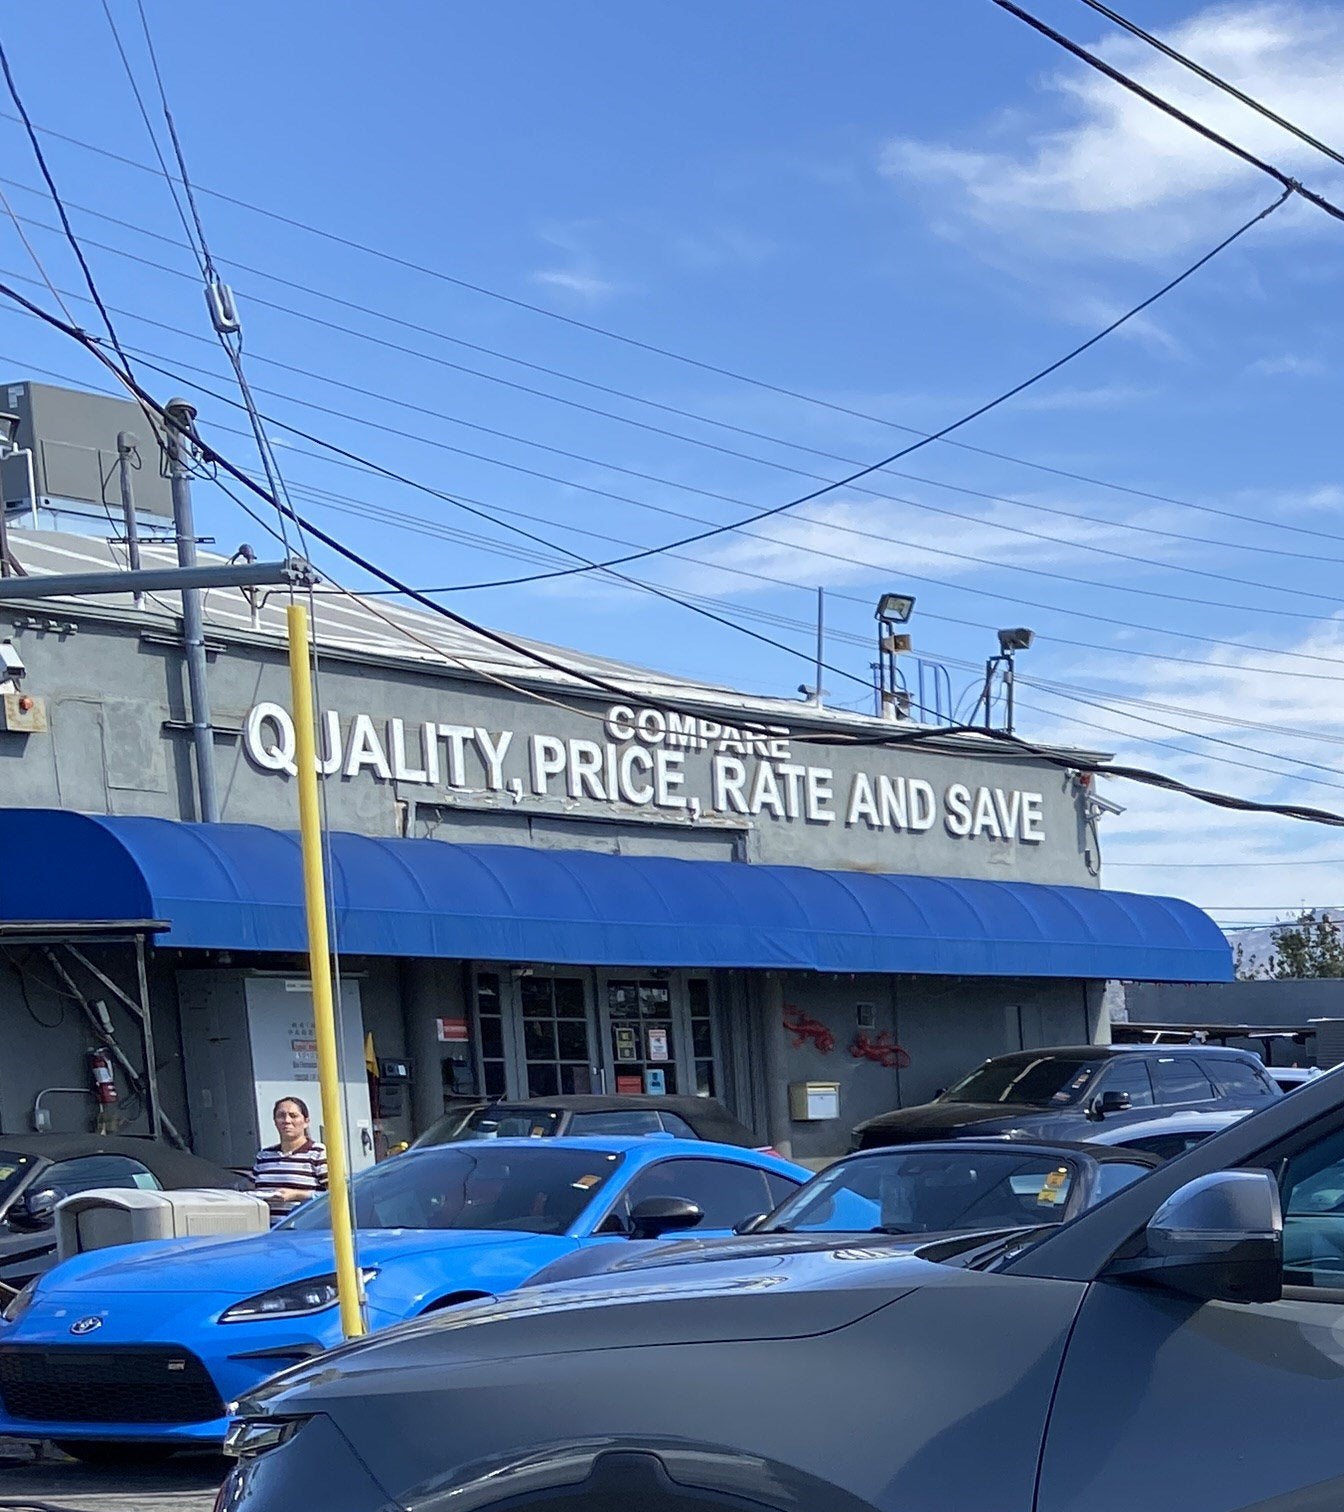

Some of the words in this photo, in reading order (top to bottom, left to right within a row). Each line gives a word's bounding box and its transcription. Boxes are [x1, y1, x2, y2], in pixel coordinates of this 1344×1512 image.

[245, 701, 524, 803] QUALITY,
[528, 734, 700, 820] PRICE,
[712, 754, 837, 822] RATE
[847, 771, 938, 831] AND
[943, 782, 1046, 843] SAVE
[606, 704, 792, 759] COMPARE
